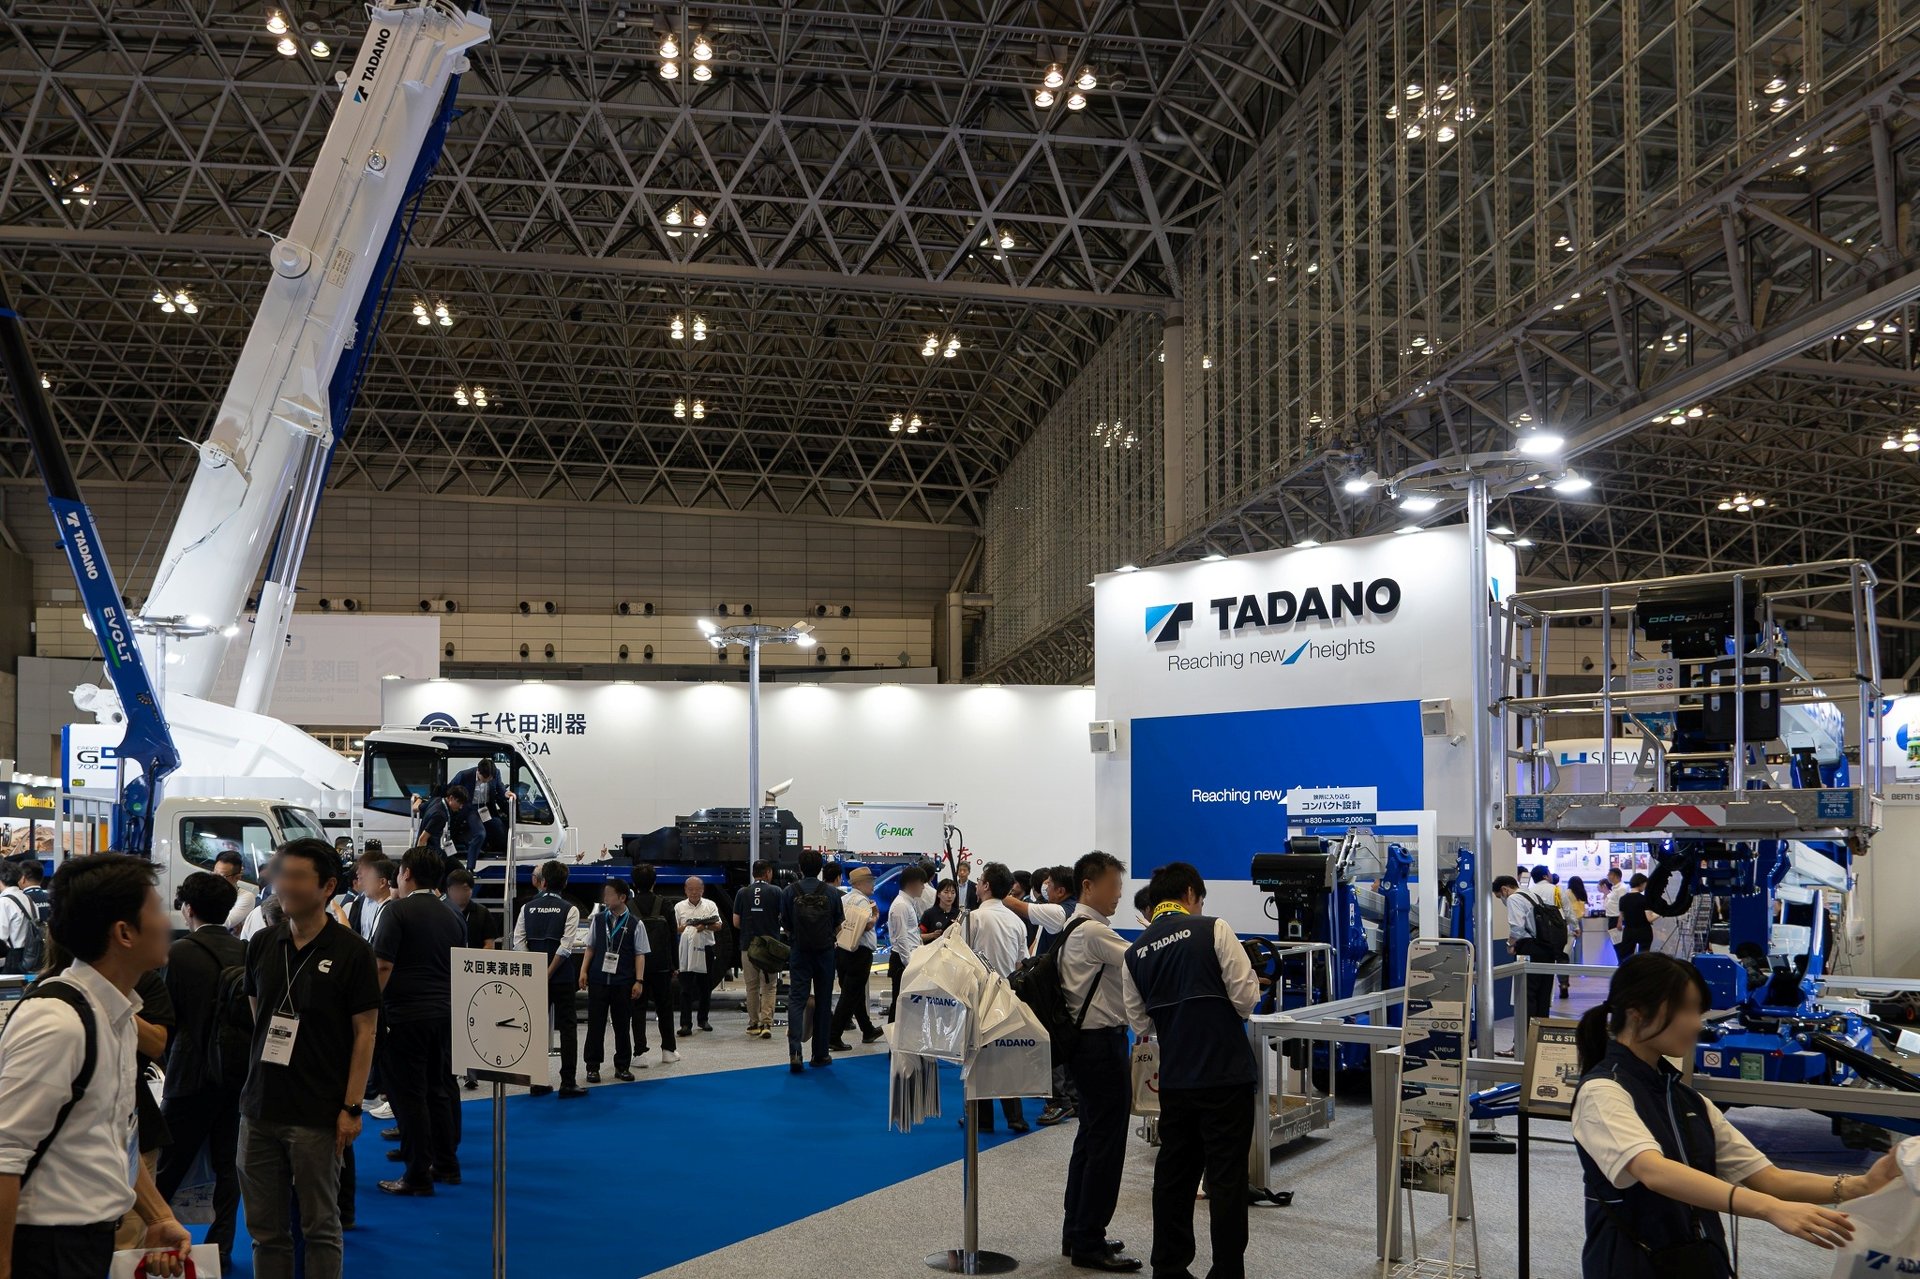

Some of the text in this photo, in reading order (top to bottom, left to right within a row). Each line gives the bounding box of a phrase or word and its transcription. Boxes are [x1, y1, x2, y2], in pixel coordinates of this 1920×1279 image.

[361, 28, 391, 81] TADANO
[74, 530, 99, 580] TADANO
[1210, 577, 1401, 630] TADANO
[104, 606, 132, 662] EVOLT
[1168, 639, 1375, 671] Reaching new heights
[470, 712, 587, 735] 千代田測器
[1192, 788, 1282, 804] Reaching new
[1302, 801, 1362, 810] コンパクト設計
[881, 827, 914, 837] e-PACK
[1150, 929, 1191, 951] TADANO
[463, 960, 533, 977] 次回実演時間
[494, 984, 502, 994] 12
[926, 996, 957, 1007] TADANO
[469, 1017, 475, 1026] 9
[523, 1022, 529, 1032] 3
[995, 1039, 1036, 1047] TADANO
[496, 1055, 501, 1065] 6
